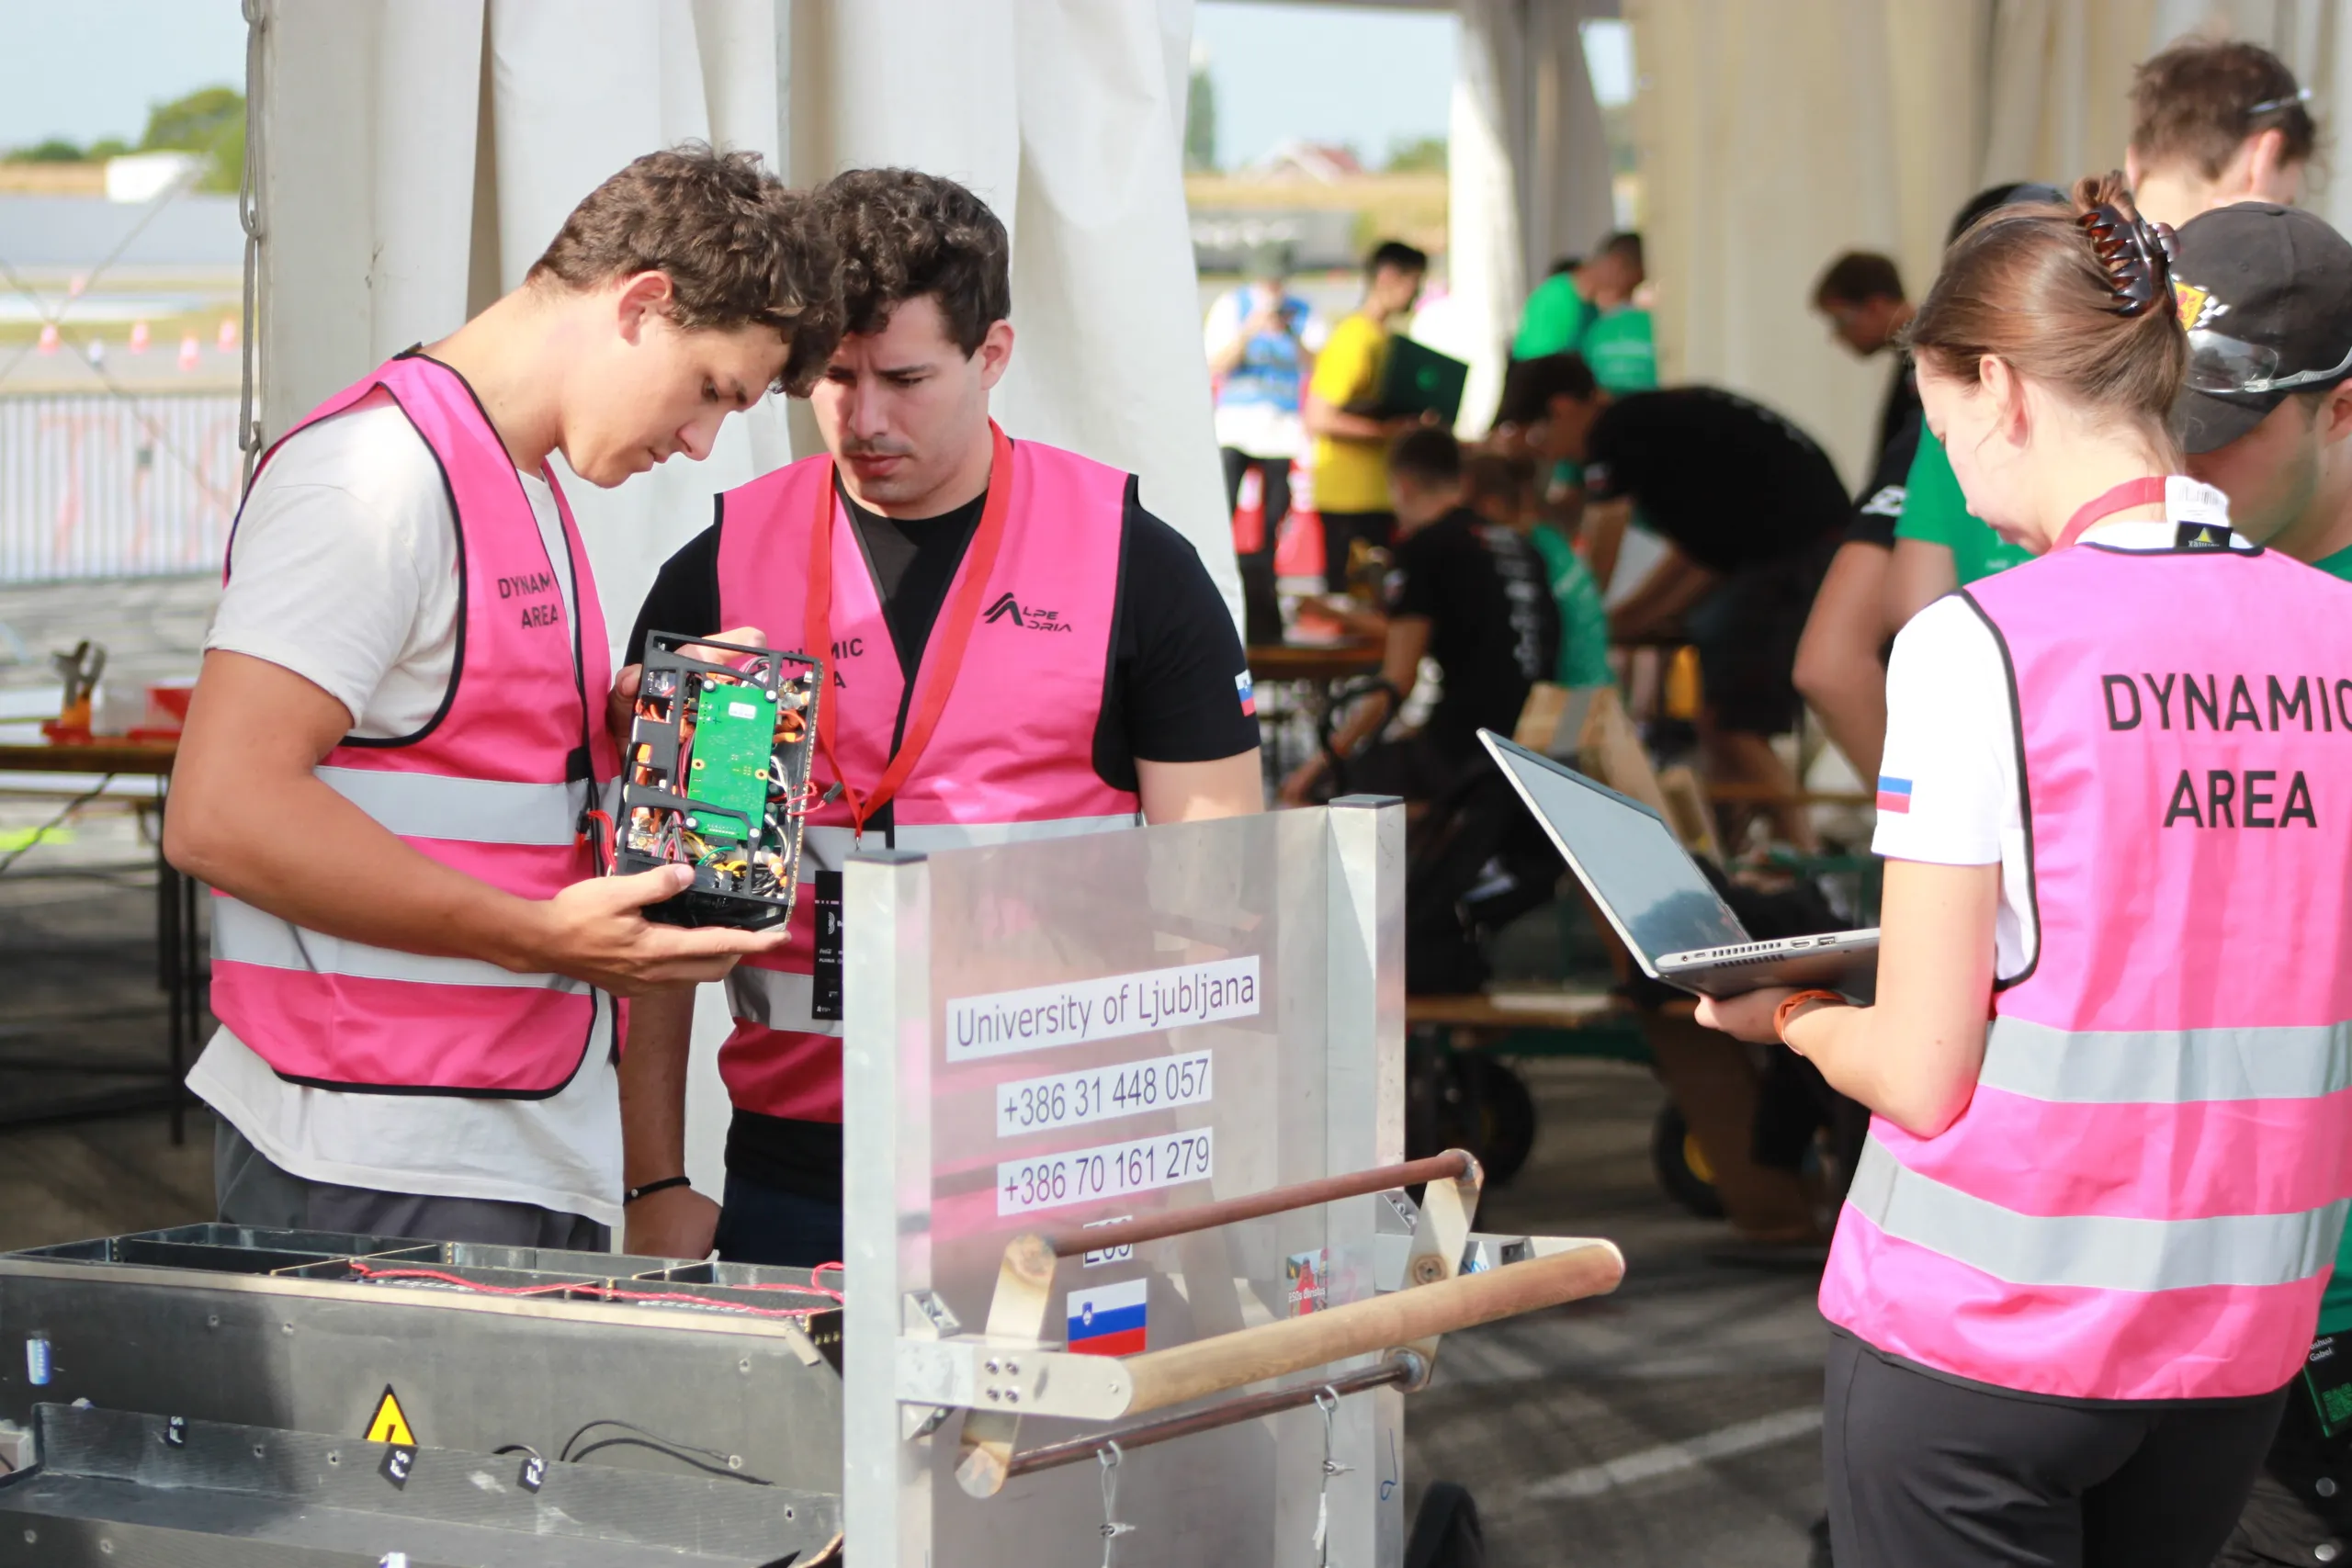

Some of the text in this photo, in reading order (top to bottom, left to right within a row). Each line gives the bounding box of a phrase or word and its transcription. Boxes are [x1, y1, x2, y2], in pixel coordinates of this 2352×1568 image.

[497, 571, 551, 599] DYNAM
[521, 604, 559, 629] AREA
[2162, 768, 2317, 829] AREA
[956, 973, 1254, 1047] University of Ljubljana
[1004, 1057, 1209, 1126] +386 31 448 057
[1004, 1135, 1209, 1205] +386 70 161 279
[2309, 1347, 2333, 1361] Gabel
[2310, 1337, 2334, 1350] oshua
